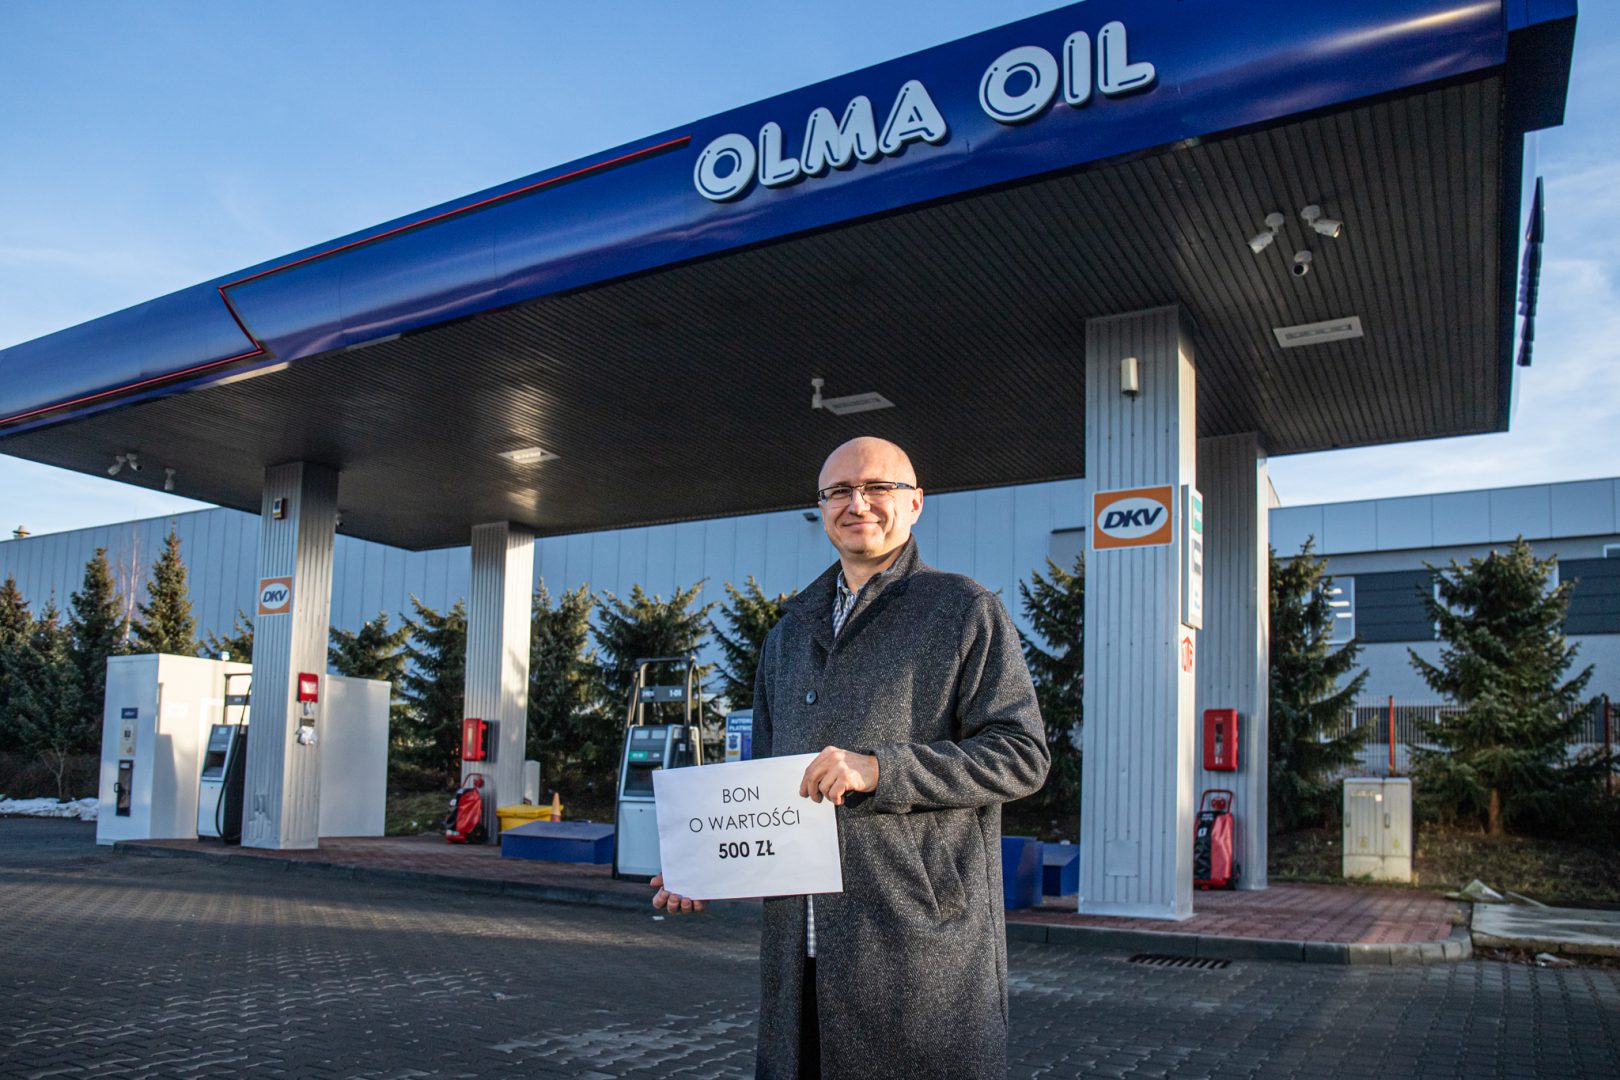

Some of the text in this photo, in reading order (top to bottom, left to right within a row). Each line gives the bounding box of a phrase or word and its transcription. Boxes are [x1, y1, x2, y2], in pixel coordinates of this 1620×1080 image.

[694, 20, 1156, 201] OLMA OIL
[1103, 506, 1163, 529] DKV
[263, 589, 288, 603] DKV
[722, 786, 760, 804] BON
[689, 806, 801, 833] O WARTOŚĆI
[718, 840, 775, 859] 500 ZŁ
